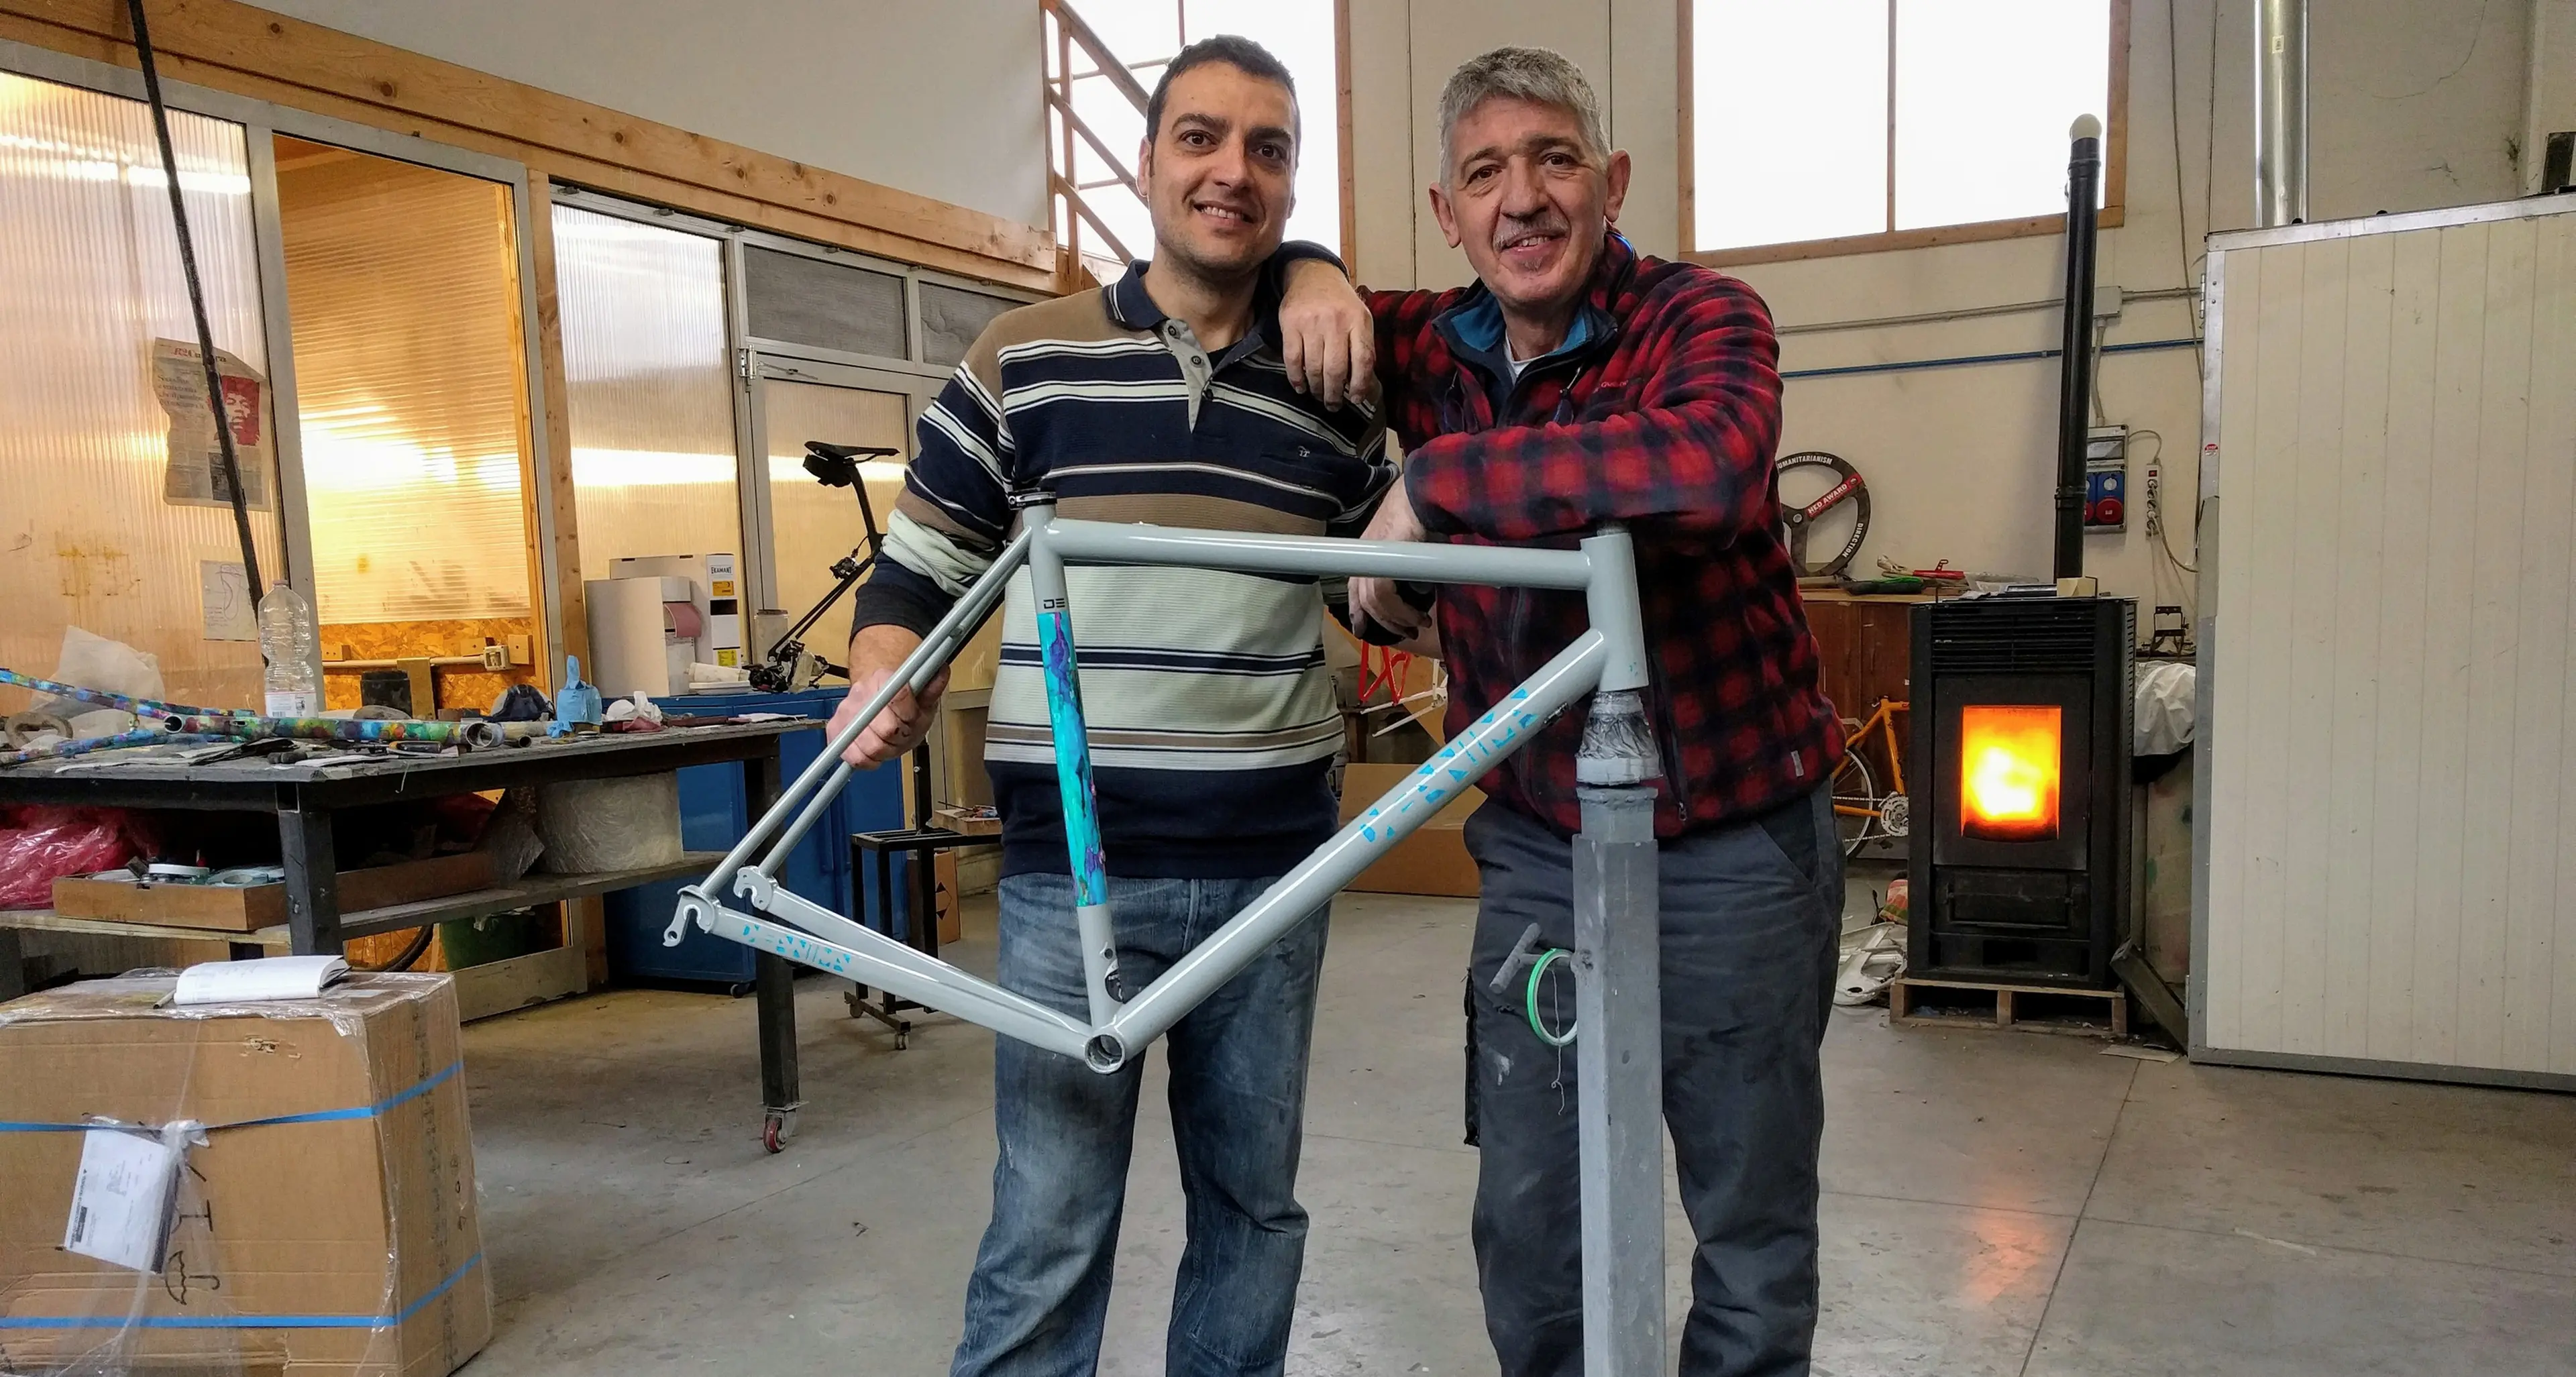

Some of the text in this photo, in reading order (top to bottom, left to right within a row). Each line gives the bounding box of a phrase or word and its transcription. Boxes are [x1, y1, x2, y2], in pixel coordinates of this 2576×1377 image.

[1778, 455, 1833, 469] UMANITARIANISM
[1823, 484, 1847, 504] AWARD
[1842, 522, 1864, 558] DIRECTION
[710, 566, 732, 574] EKAMANT
